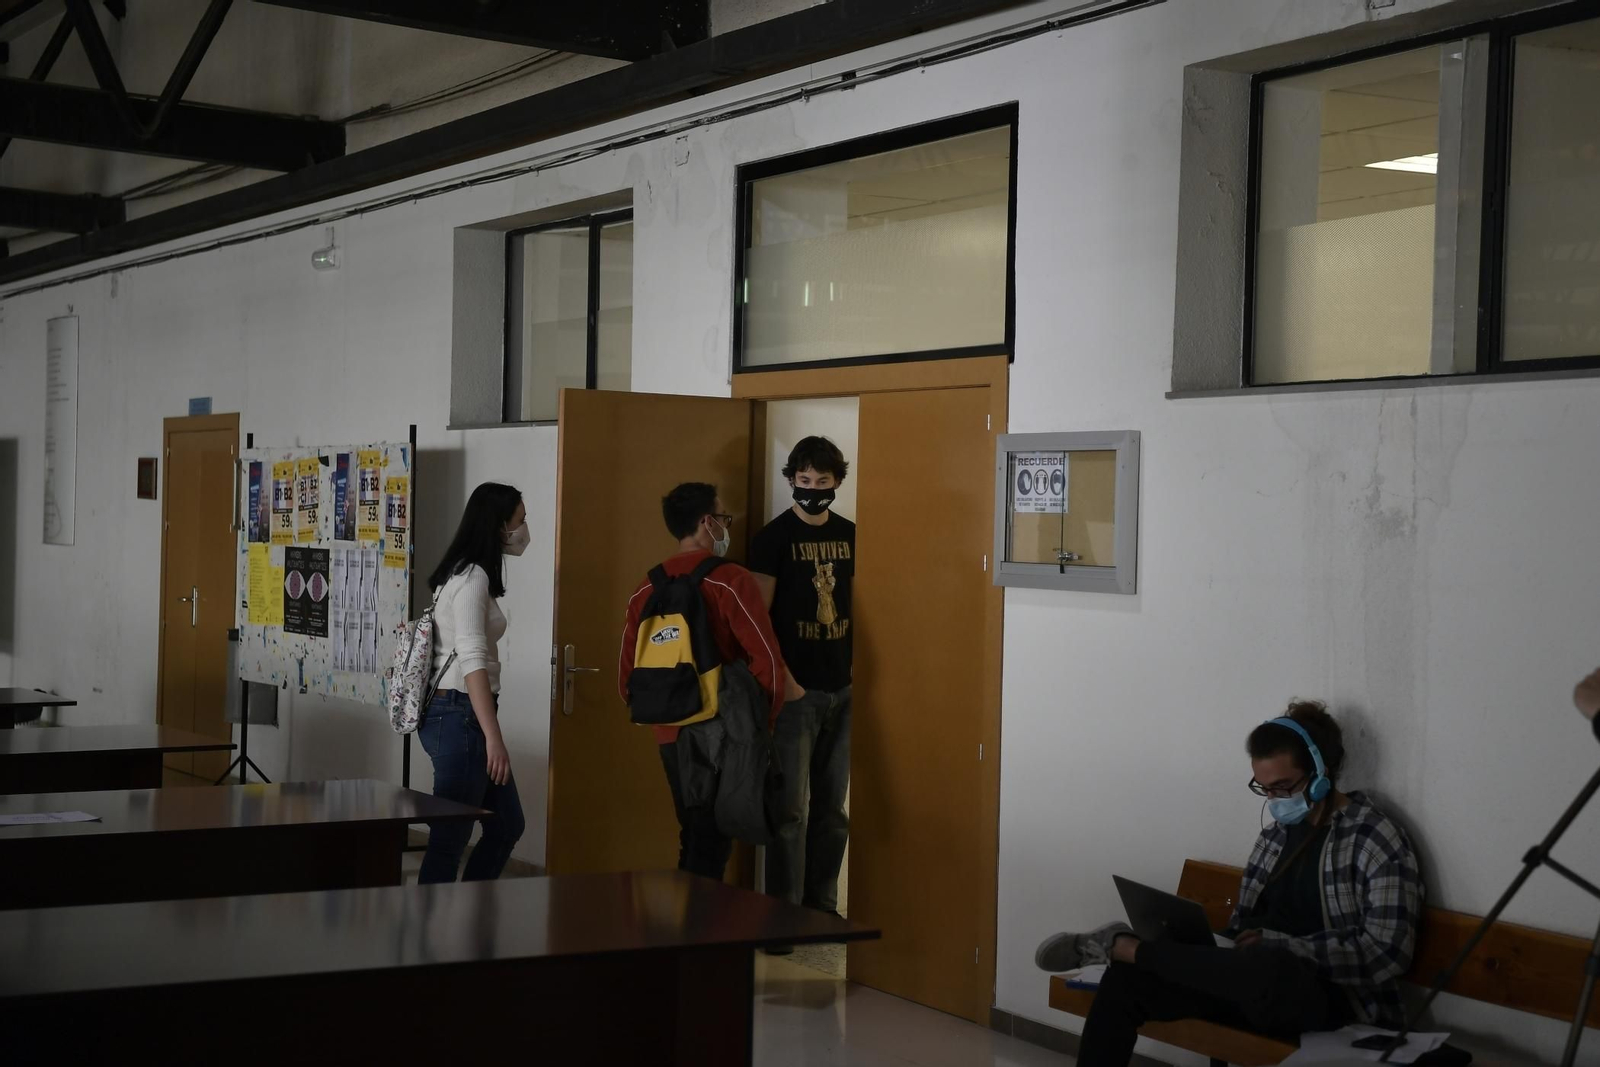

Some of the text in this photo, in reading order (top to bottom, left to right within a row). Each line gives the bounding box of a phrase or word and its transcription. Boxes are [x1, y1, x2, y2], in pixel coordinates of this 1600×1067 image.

[1018, 458, 1065, 466] RECUERDE
[370, 478, 379, 491] B2
[284, 487, 293, 501] B2
[397, 504, 406, 519] B2
[799, 542, 850, 560] SURVIVED
[797, 622, 820, 639] THE
